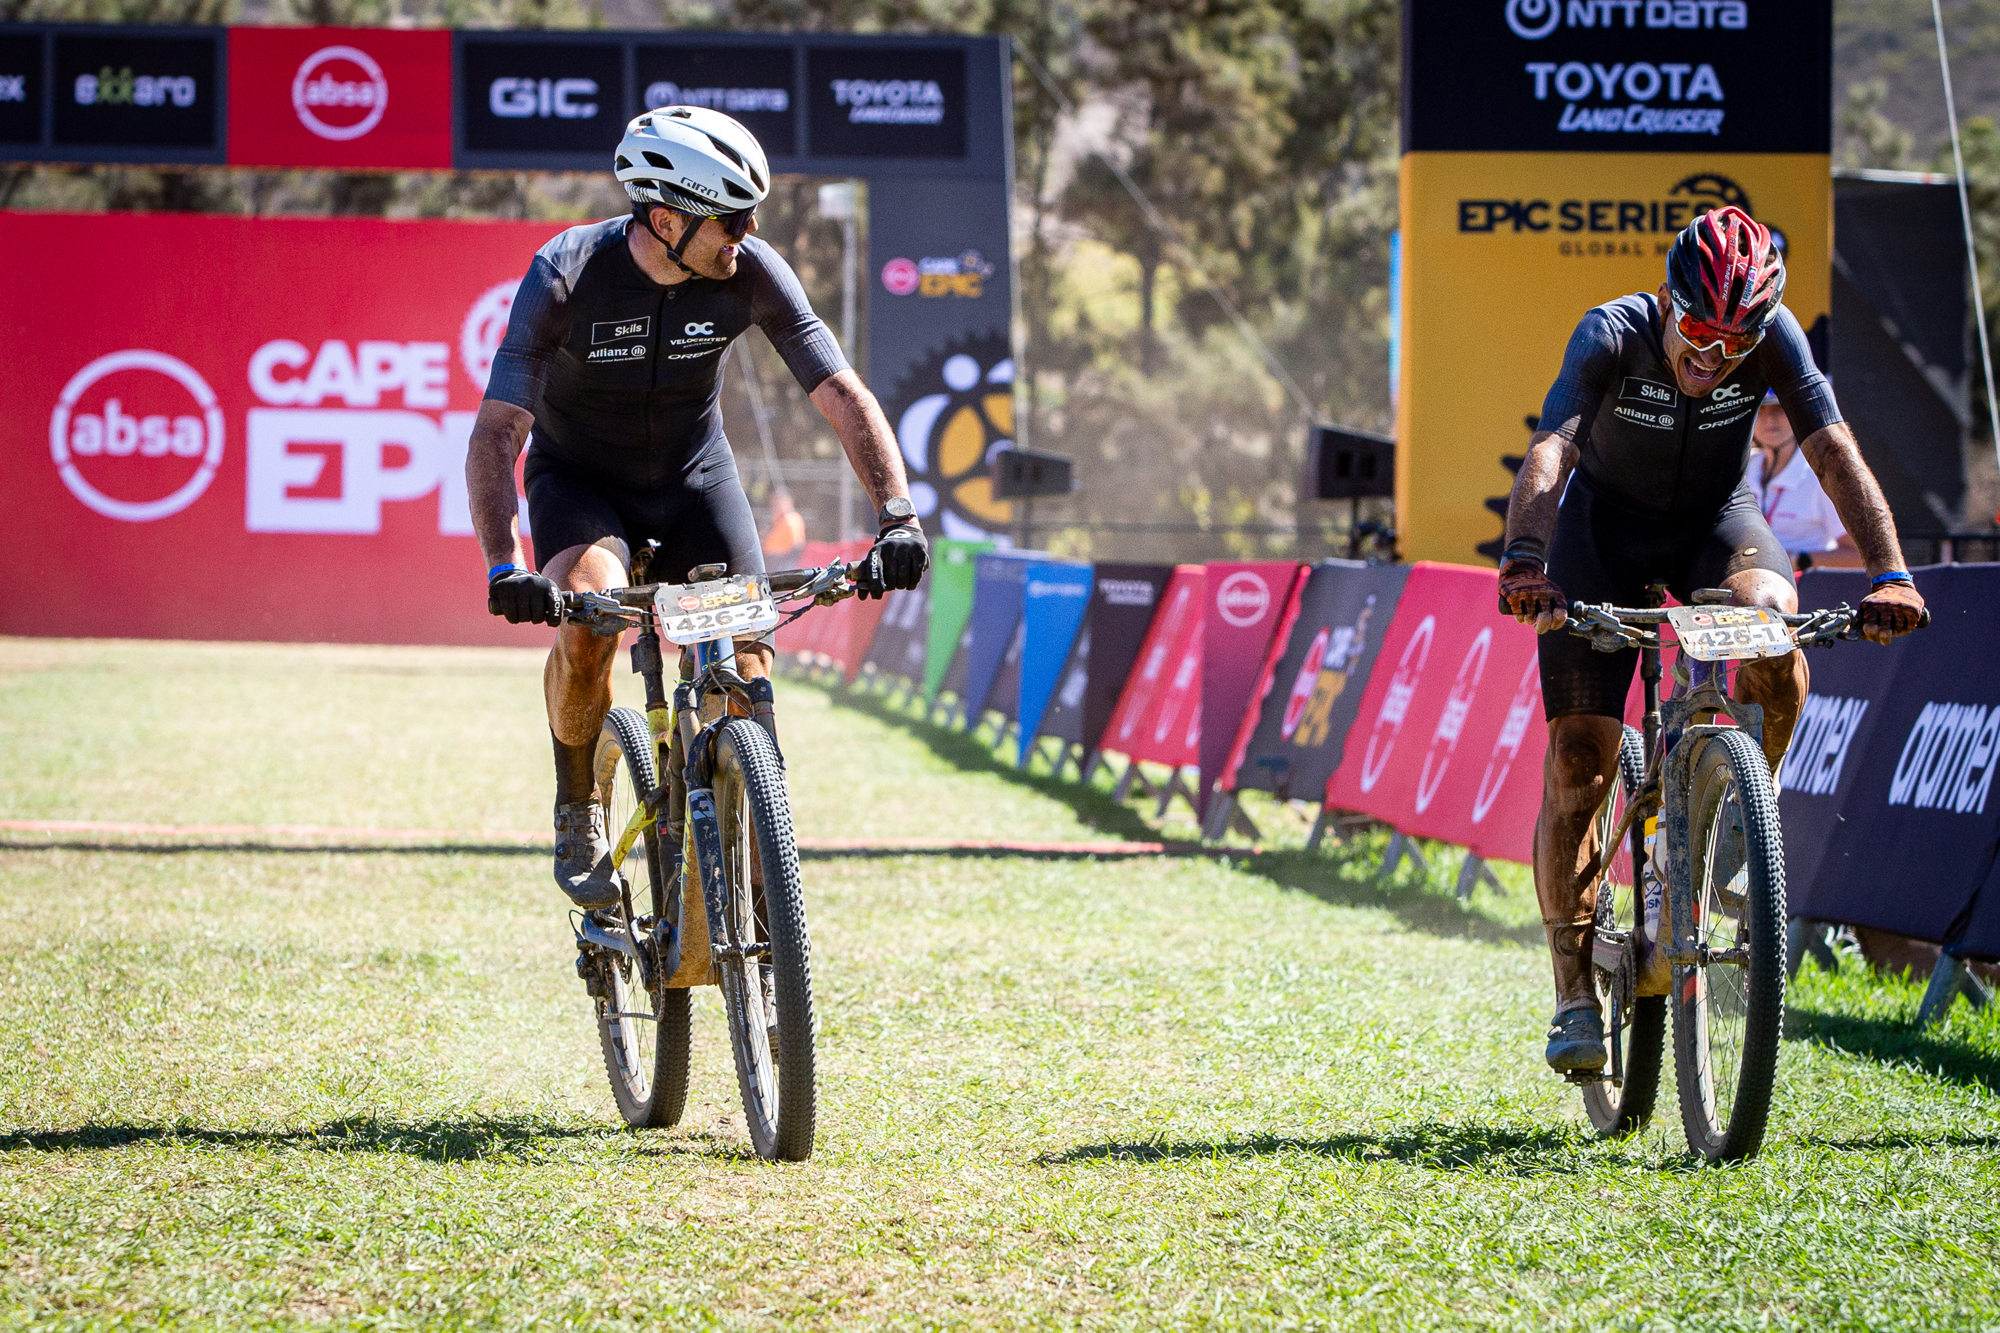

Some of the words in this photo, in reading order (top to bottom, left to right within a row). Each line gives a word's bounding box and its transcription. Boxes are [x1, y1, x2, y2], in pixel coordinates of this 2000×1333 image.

[1567, 0, 1642, 28] NTT
[306, 72, 374, 107] absa
[831, 79, 944, 106] TOYOTA
[1525, 61, 1725, 101] TOYOTA
[489, 77, 599, 118] GIC
[1459, 200, 1552, 232] EPIC
[1559, 241, 1644, 257] GLOBAL
[615, 324, 642, 337] Skils
[670, 337, 727, 345] VELOCENTER
[588, 347, 628, 359] Allianz
[248, 339, 449, 408] CAPE
[1641, 384, 1671, 401] Skils
[1700, 395, 1755, 414] VELOCENTER
[1614, 406, 1656, 423] Allianz
[70, 399, 205, 458] absa
[246, 408, 529, 536] EPI
[703, 592, 743, 609] EPIC
[676, 604, 766, 632] 426-2
[1714, 614, 1754, 625] EPIC
[1697, 626, 1776, 647] 426-1
